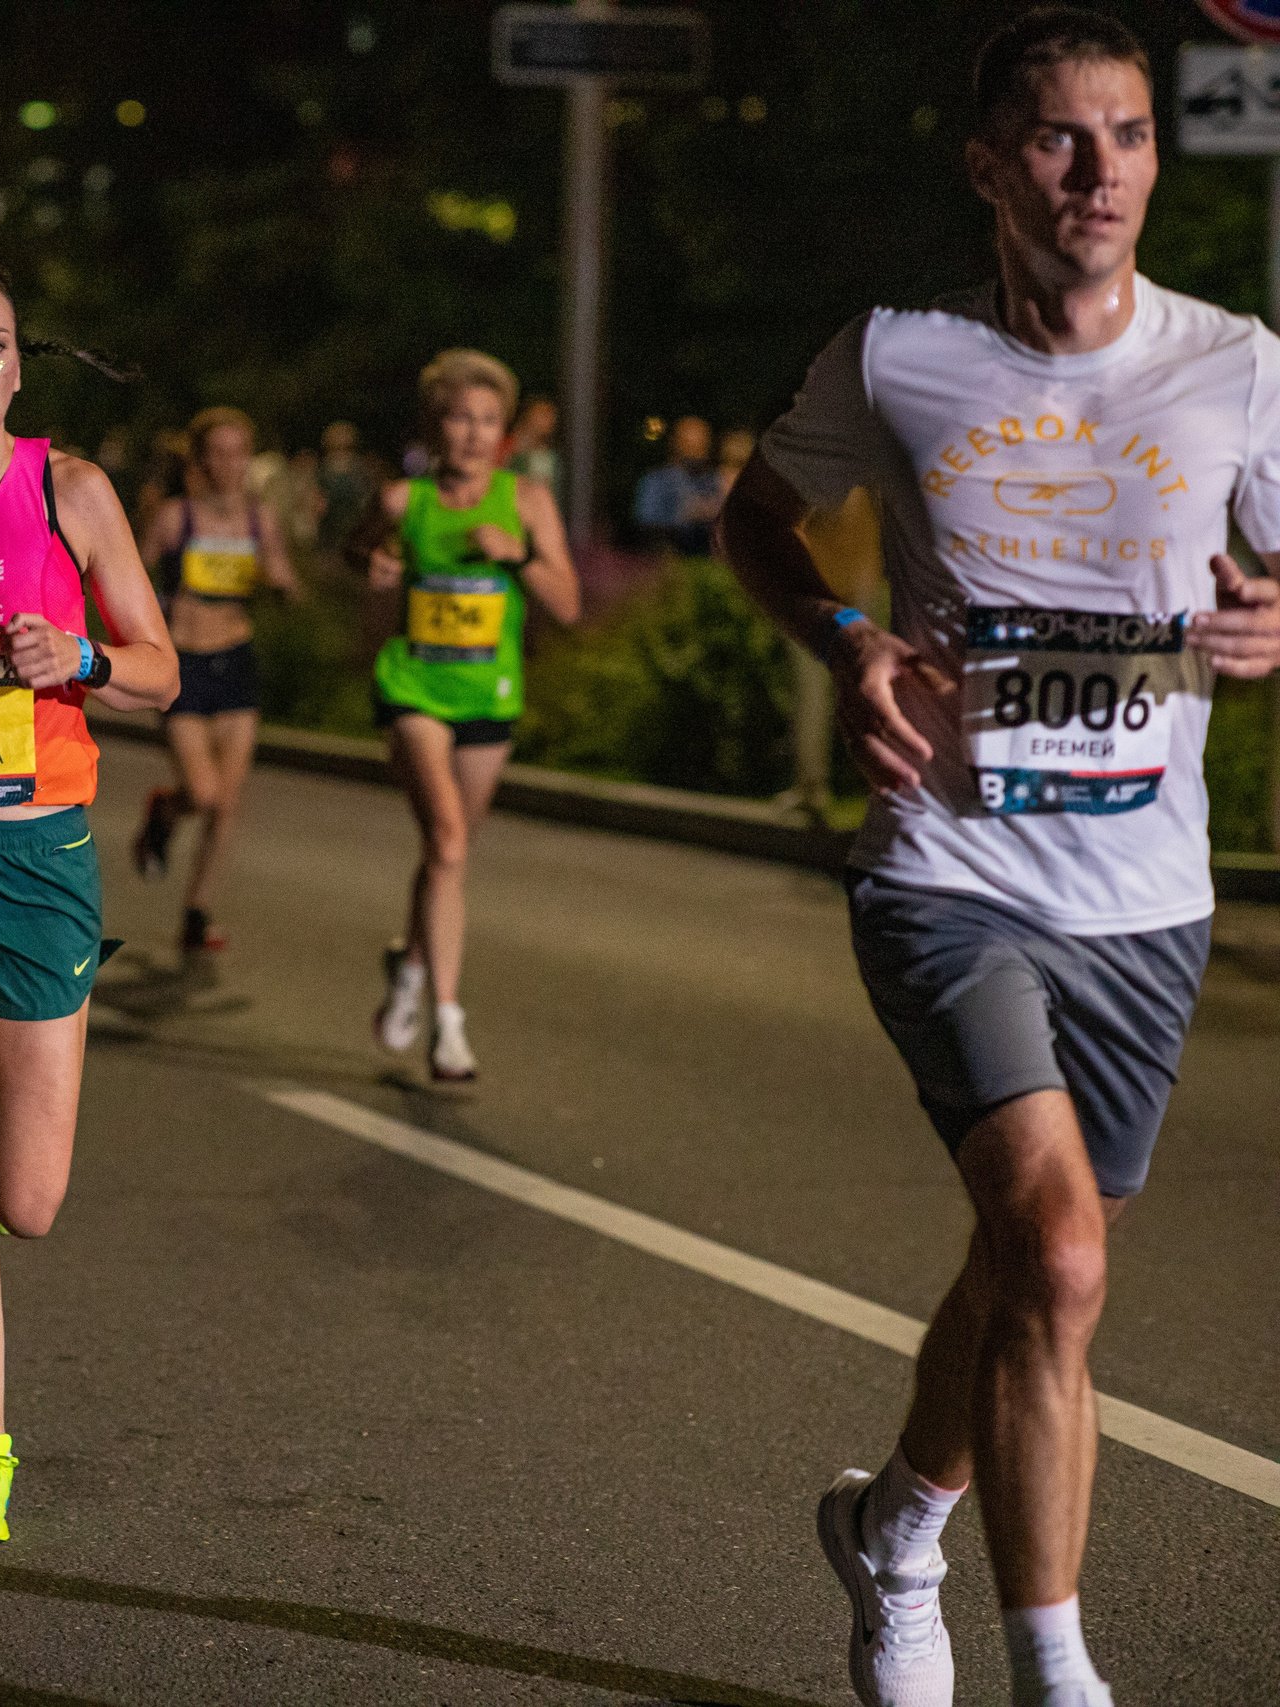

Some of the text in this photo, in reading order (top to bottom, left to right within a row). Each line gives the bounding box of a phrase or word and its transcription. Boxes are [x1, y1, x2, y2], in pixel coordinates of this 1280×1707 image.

[923, 413, 1101, 499] REEBOK
[951, 533, 1167, 562] ATHLETICS
[995, 669, 1150, 732] 8006
[1031, 737, 1116, 758] ЕРЕМЕЙ
